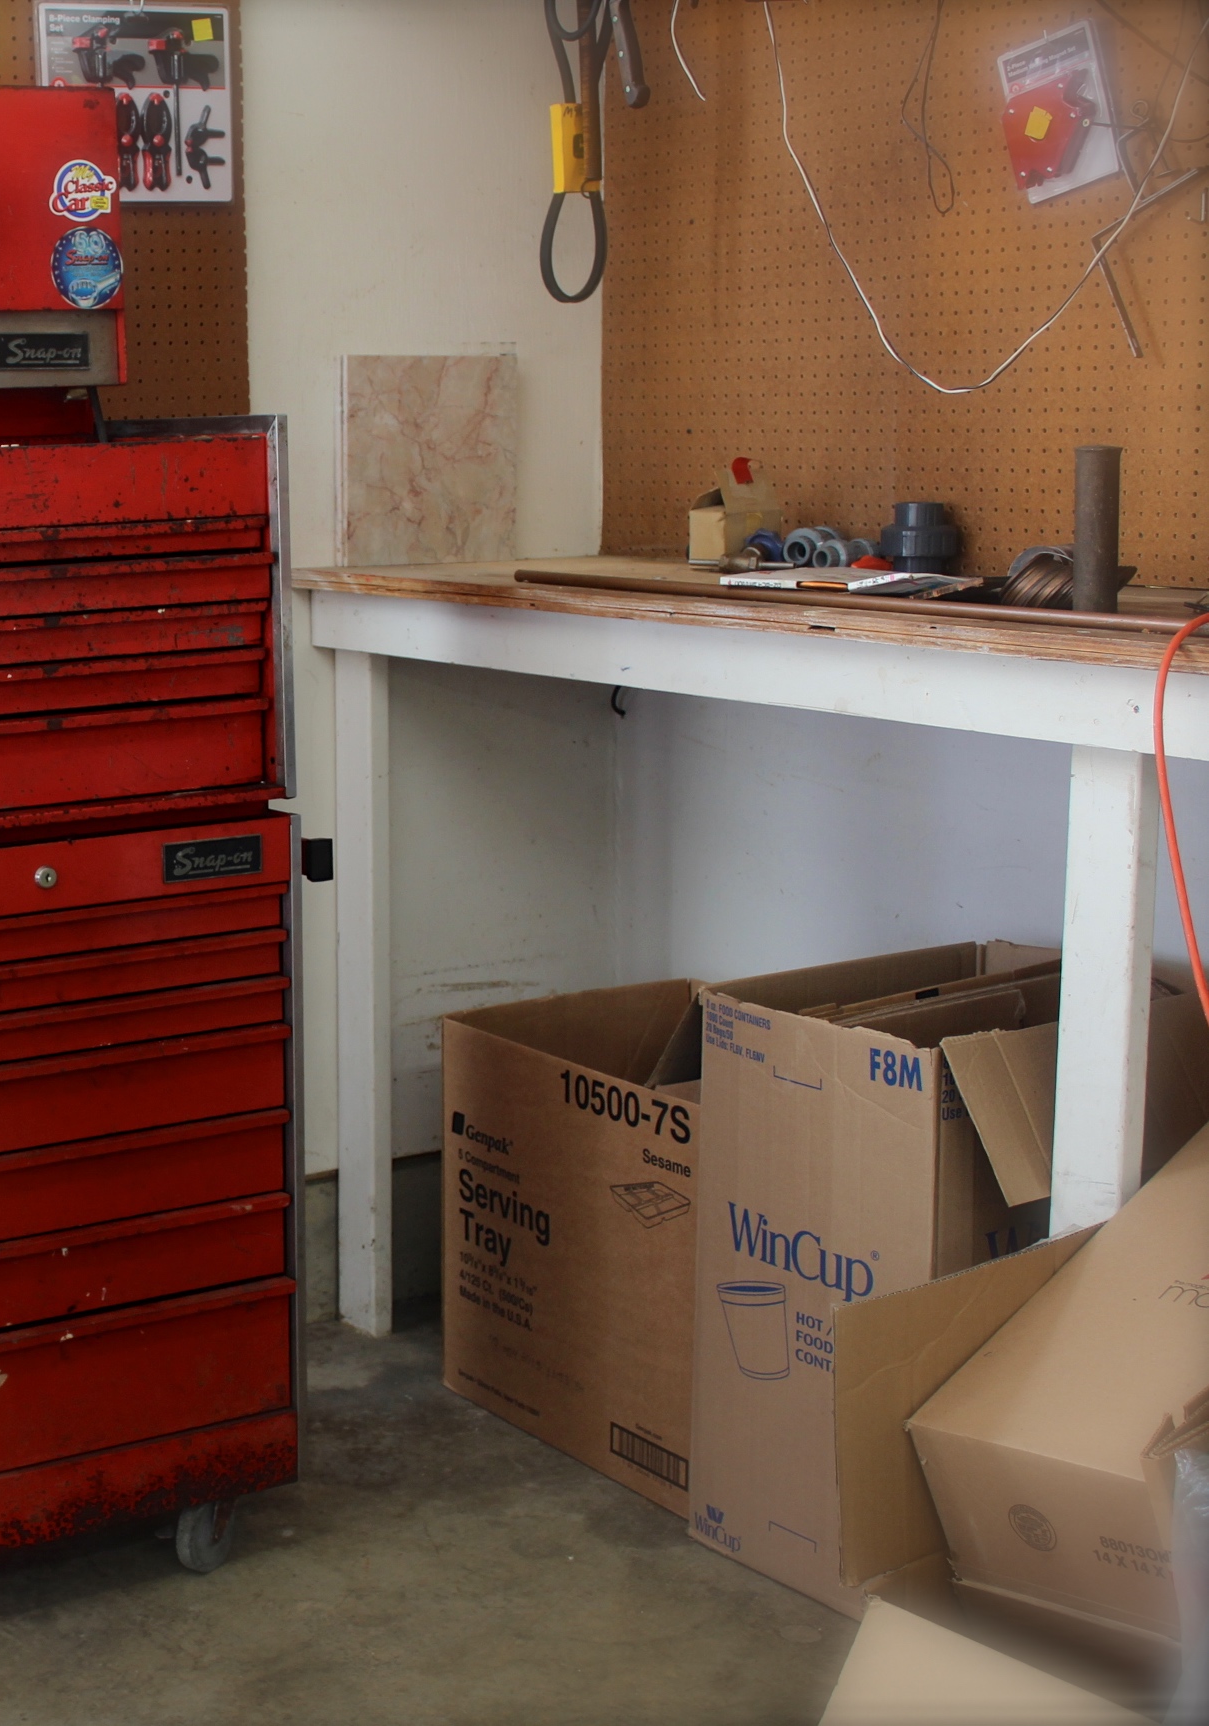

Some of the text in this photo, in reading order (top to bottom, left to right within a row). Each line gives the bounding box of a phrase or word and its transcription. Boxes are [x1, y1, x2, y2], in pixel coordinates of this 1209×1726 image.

[49, 24, 64, 32] Set
[82, 14, 121, 25] Clamping
[64, 178, 113, 194] Classic
[52, 192, 90, 212] Car
[65, 249, 109, 266] Snap-on
[5, 338, 81, 364] Snap-on
[173, 846, 253, 876] Snap-on
[719, 1004, 733, 1018] FOOD
[734, 1009, 771, 1031] CONTAINERS
[719, 1016, 734, 1029] Count
[706, 1033, 715, 1045] Use
[716, 1036, 729, 1050] Lids:
[870, 1047, 923, 1092] F8M
[560, 1069, 691, 1144] 10500-7S
[942, 1089, 955, 1103] 20
[942, 1107, 962, 1121] Use
[465, 1150, 520, 1184] Compartment
[642, 1148, 691, 1178] Sesame
[459, 1168, 550, 1246] Serving
[459, 1207, 511, 1267] Tray
[728, 1201, 874, 1302] WinCup
[459, 1285, 482, 1307] Made
[492, 1301, 505, 1318] the
[507, 1306, 533, 1332] U.S.A.
[796, 1311, 824, 1332] HOT
[796, 1329, 833, 1354] FOOD
[795, 1348, 834, 1372] CONT
[695, 1512, 741, 1553] WinCup
[1093, 1549, 1167, 1580] 14 X 14 X
